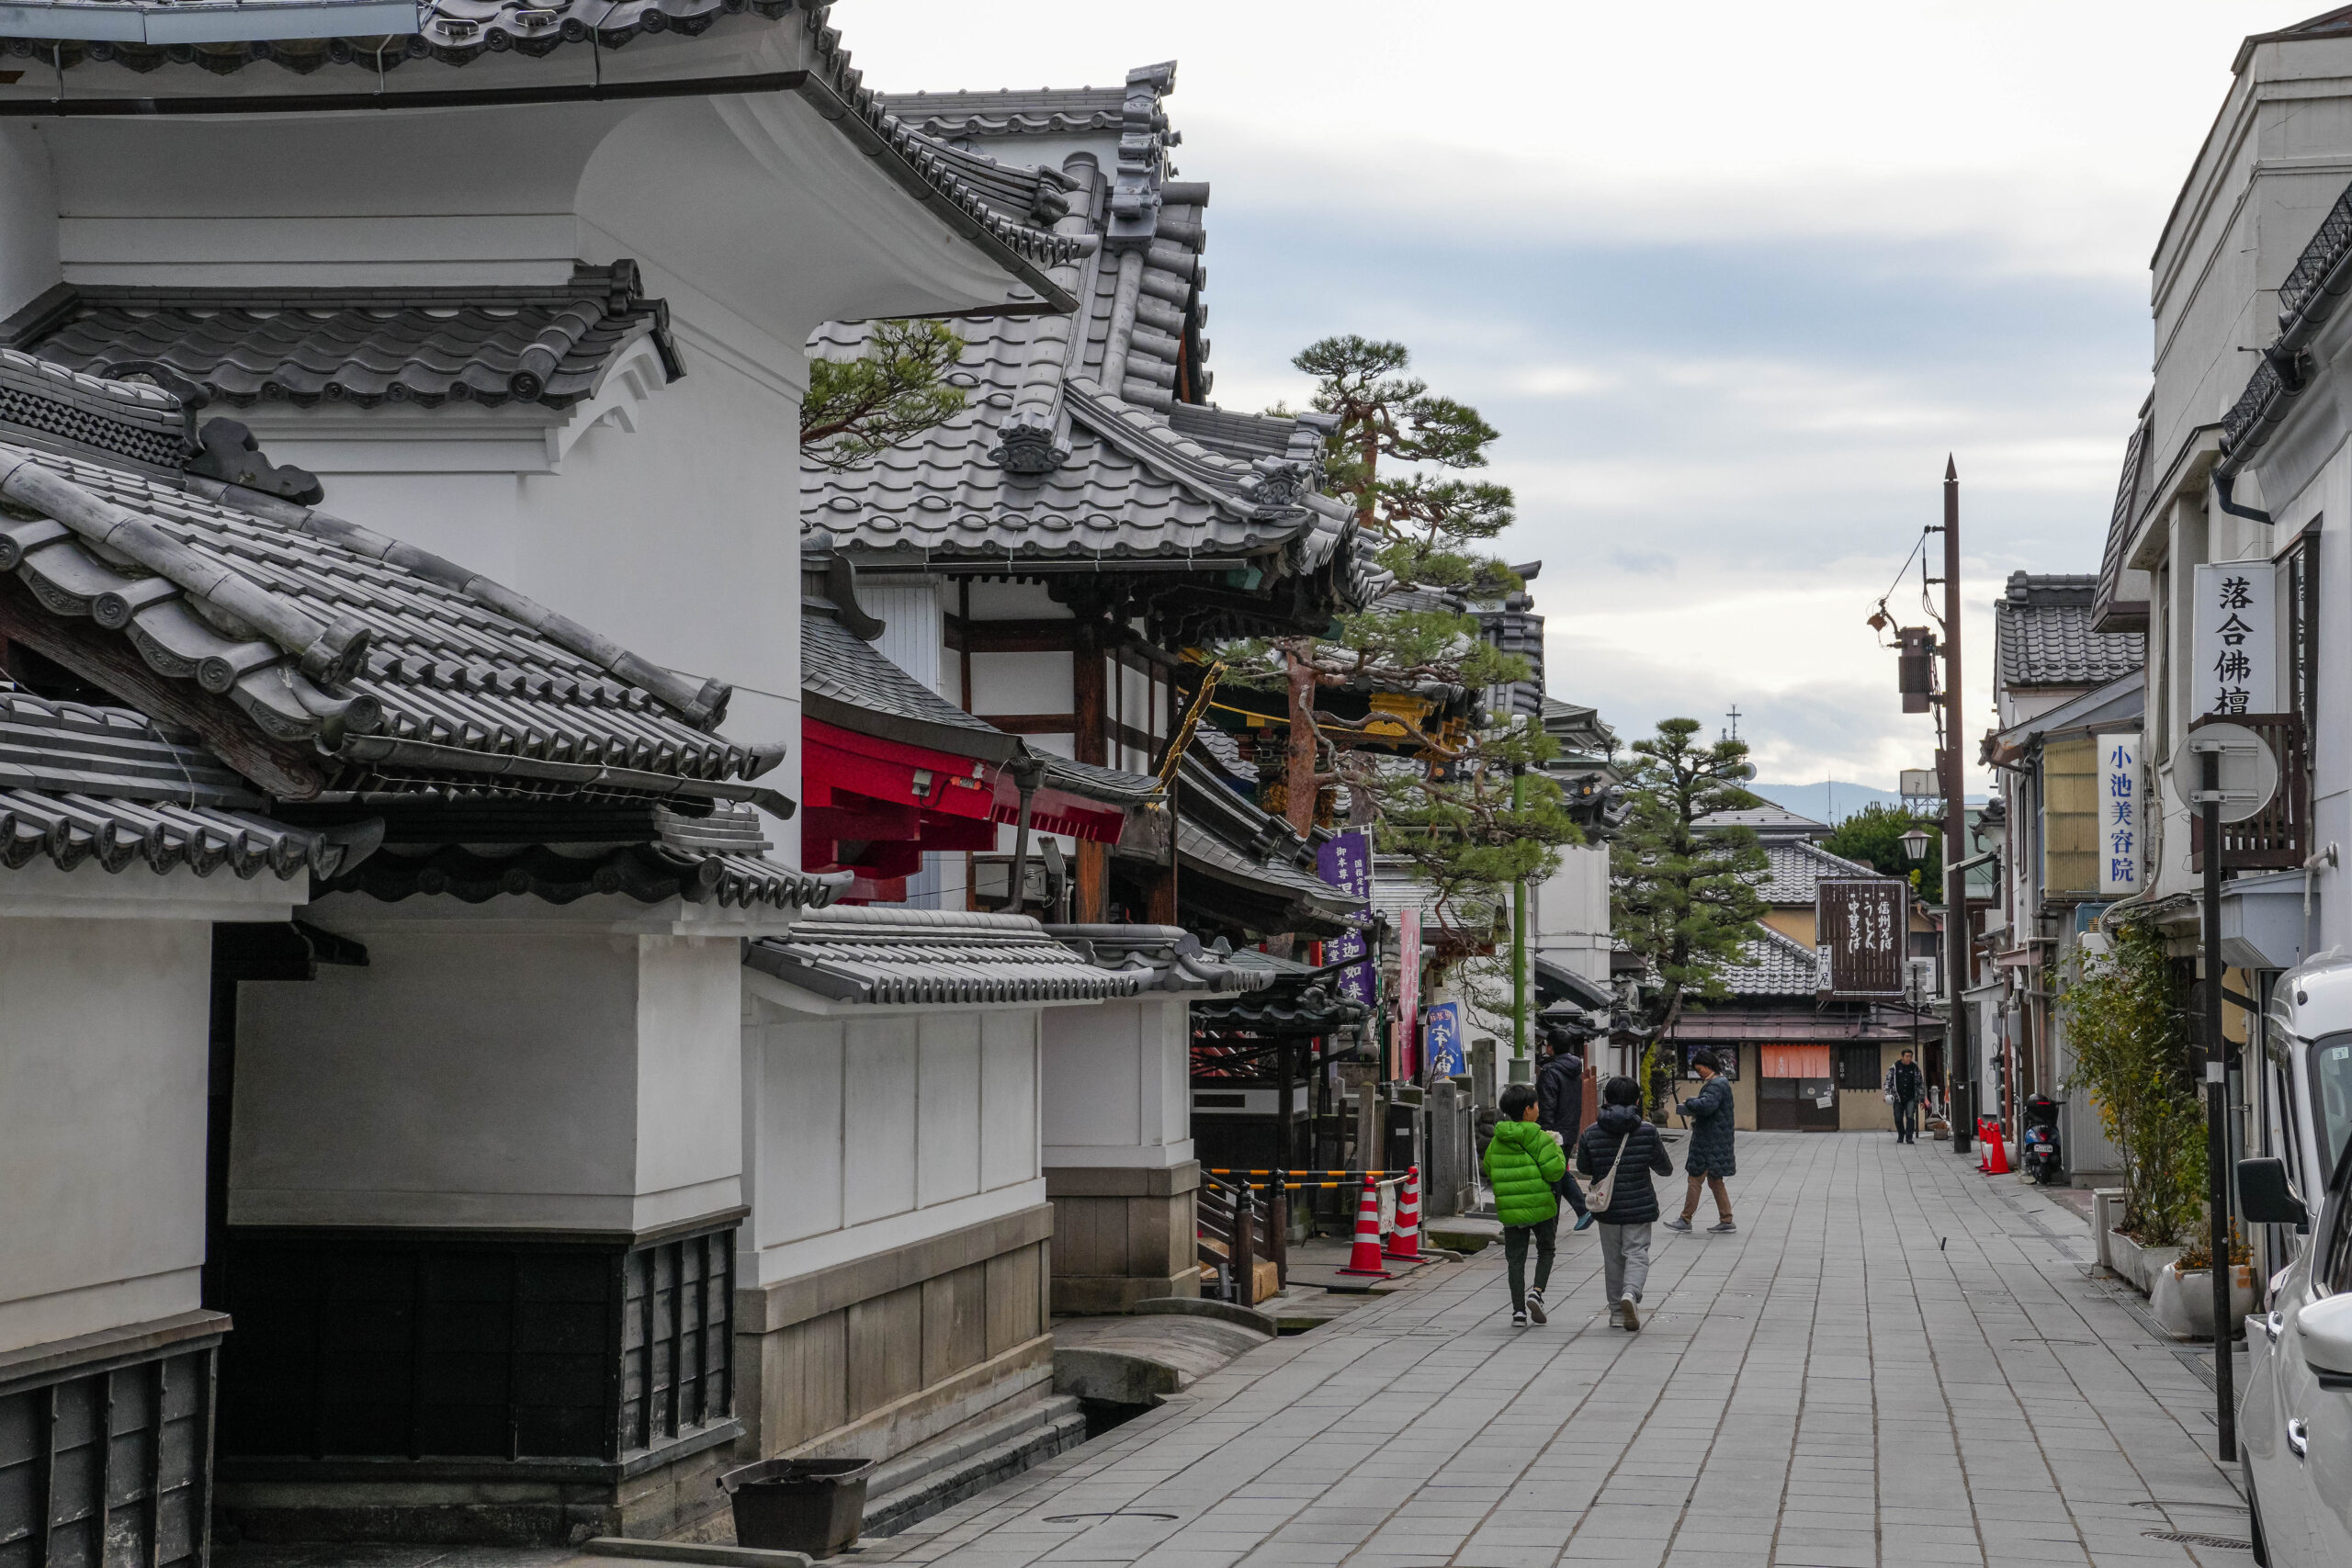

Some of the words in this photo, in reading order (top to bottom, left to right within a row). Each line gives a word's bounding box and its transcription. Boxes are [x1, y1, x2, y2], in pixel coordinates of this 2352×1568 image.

[2109, 745, 2134, 883] 小池美容院
[1848, 900, 1861, 953] 中華そば
[1863, 901, 1876, 949] うどん
[1877, 901, 1894, 953] 信州そば
